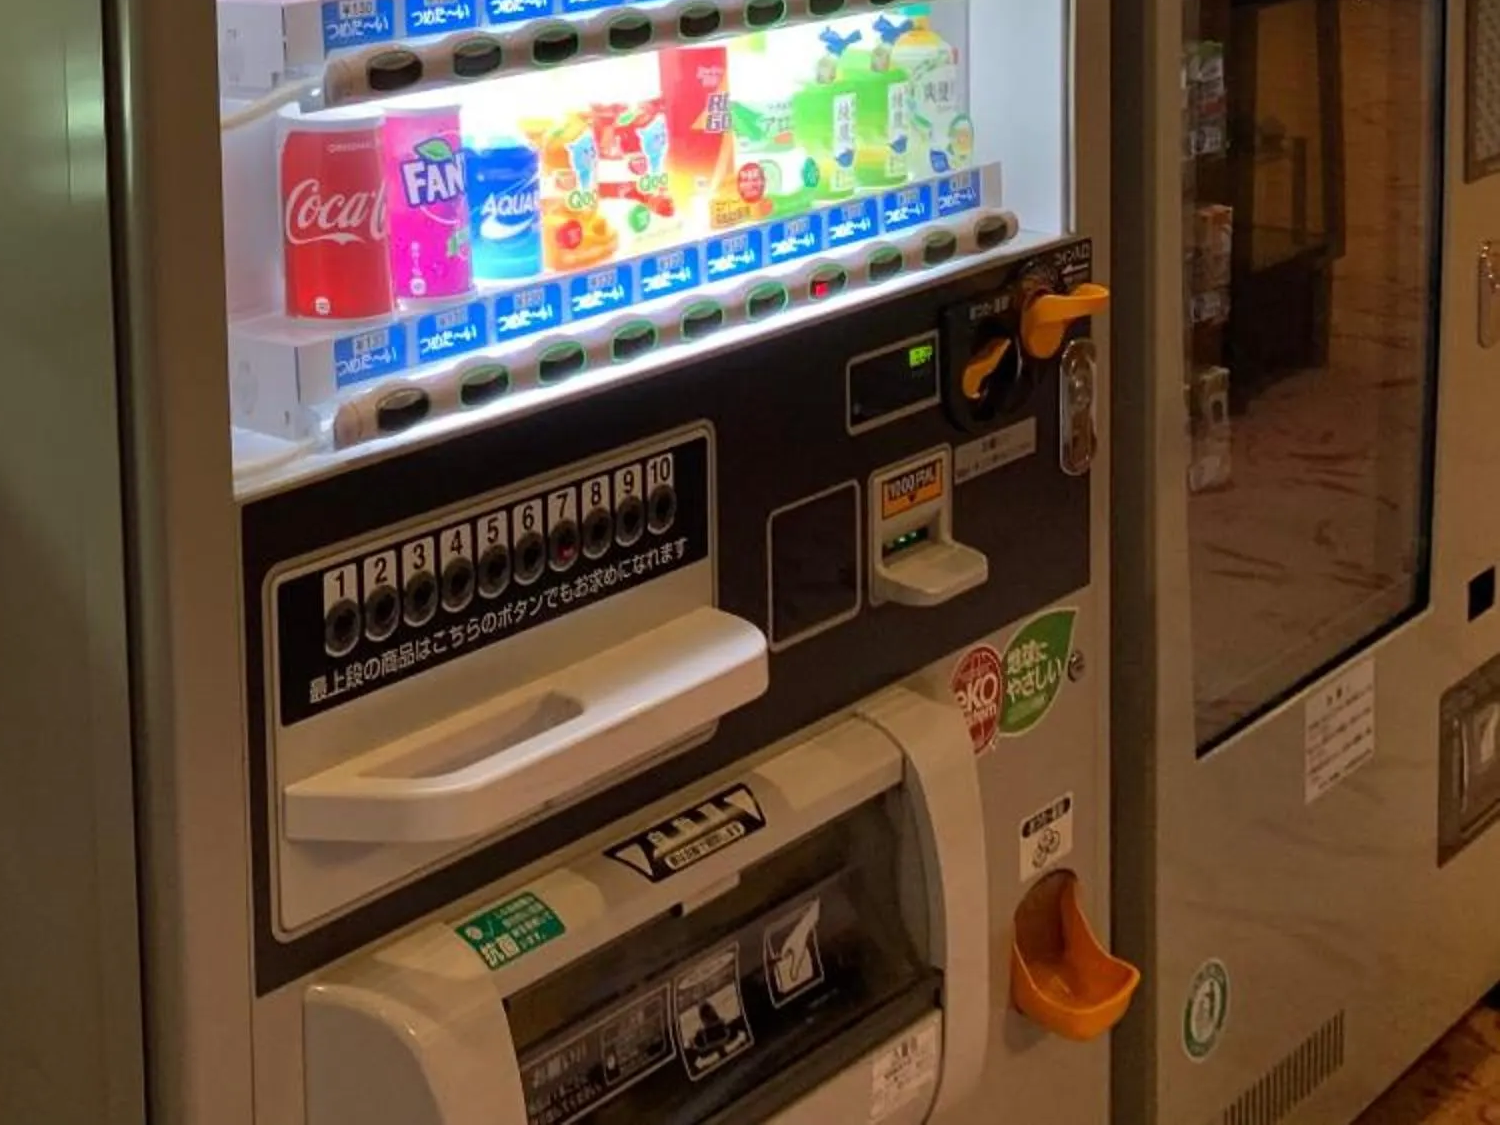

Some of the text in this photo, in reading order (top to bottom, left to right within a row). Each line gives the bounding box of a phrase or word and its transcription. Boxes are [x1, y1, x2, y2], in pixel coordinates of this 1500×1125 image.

[336, 458, 670, 597] 1 2 3 4 5 6 7 8 9 10
[309, 537, 688, 704] 最上段の商品はこちらのボタンでもお求めになれます
